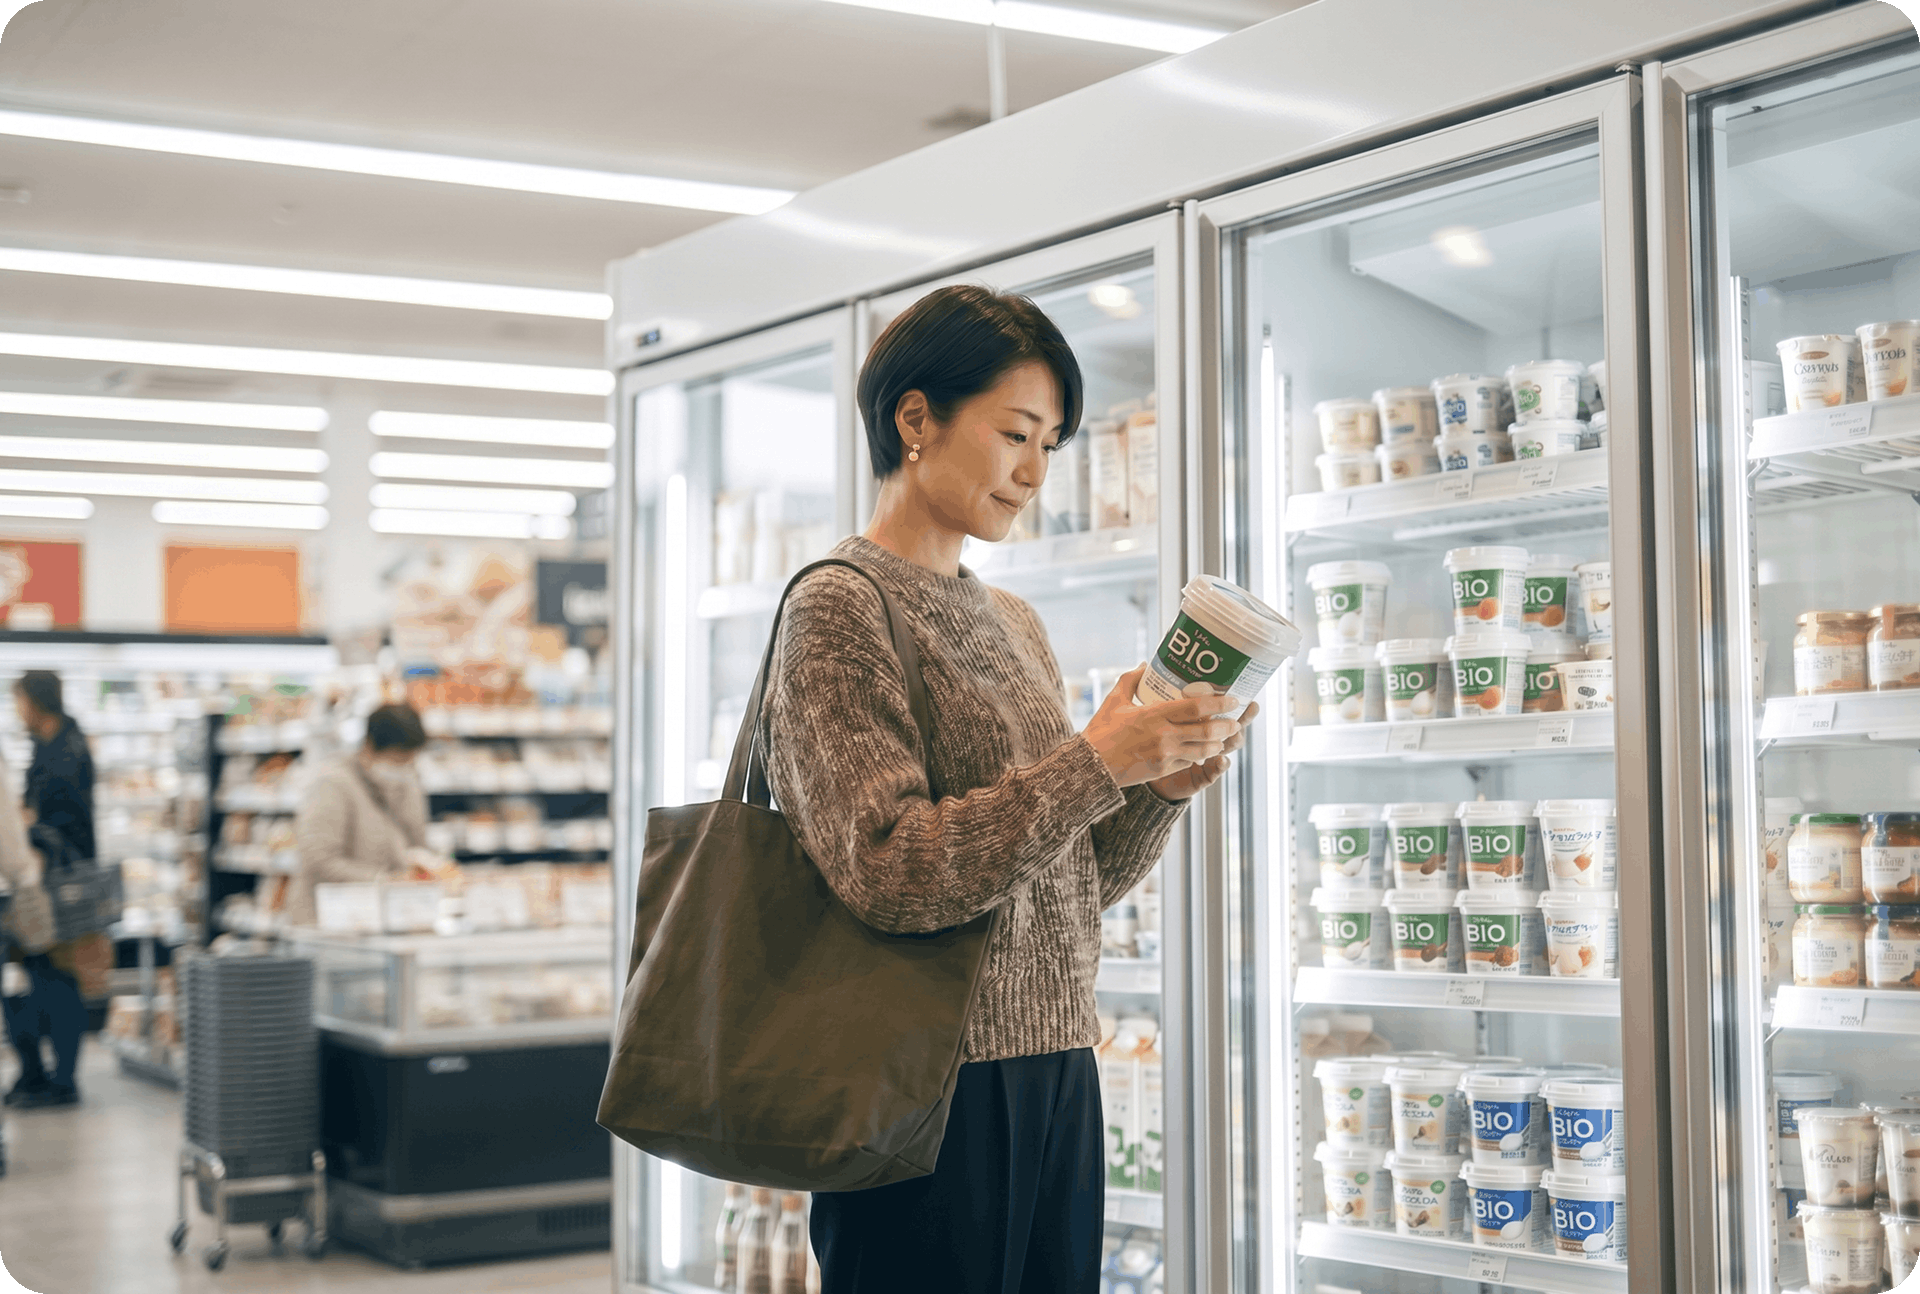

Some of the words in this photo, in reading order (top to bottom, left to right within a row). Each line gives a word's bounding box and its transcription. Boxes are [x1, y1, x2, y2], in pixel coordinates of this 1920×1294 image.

[1452, 579, 1489, 599] BIO
[1314, 593, 1349, 614] BIO
[1167, 628, 1220, 674] BIO
[1316, 676, 1352, 696] BIO
[1386, 672, 1423, 690] BIO
[1456, 667, 1493, 687] BIO
[1522, 673, 1554, 690] IO
[1319, 836, 1356, 855] BIO
[1395, 835, 1434, 854] BIO
[1469, 834, 1511, 854] BIO
[1321, 920, 1358, 939] BIO
[1394, 922, 1434, 941] BIO
[1466, 923, 1506, 942] BIO
[1473, 1110, 1513, 1131] BIO
[1552, 1118, 1594, 1139] BIO
[1474, 1200, 1514, 1220] BIO
[1554, 1209, 1595, 1231] BIO
